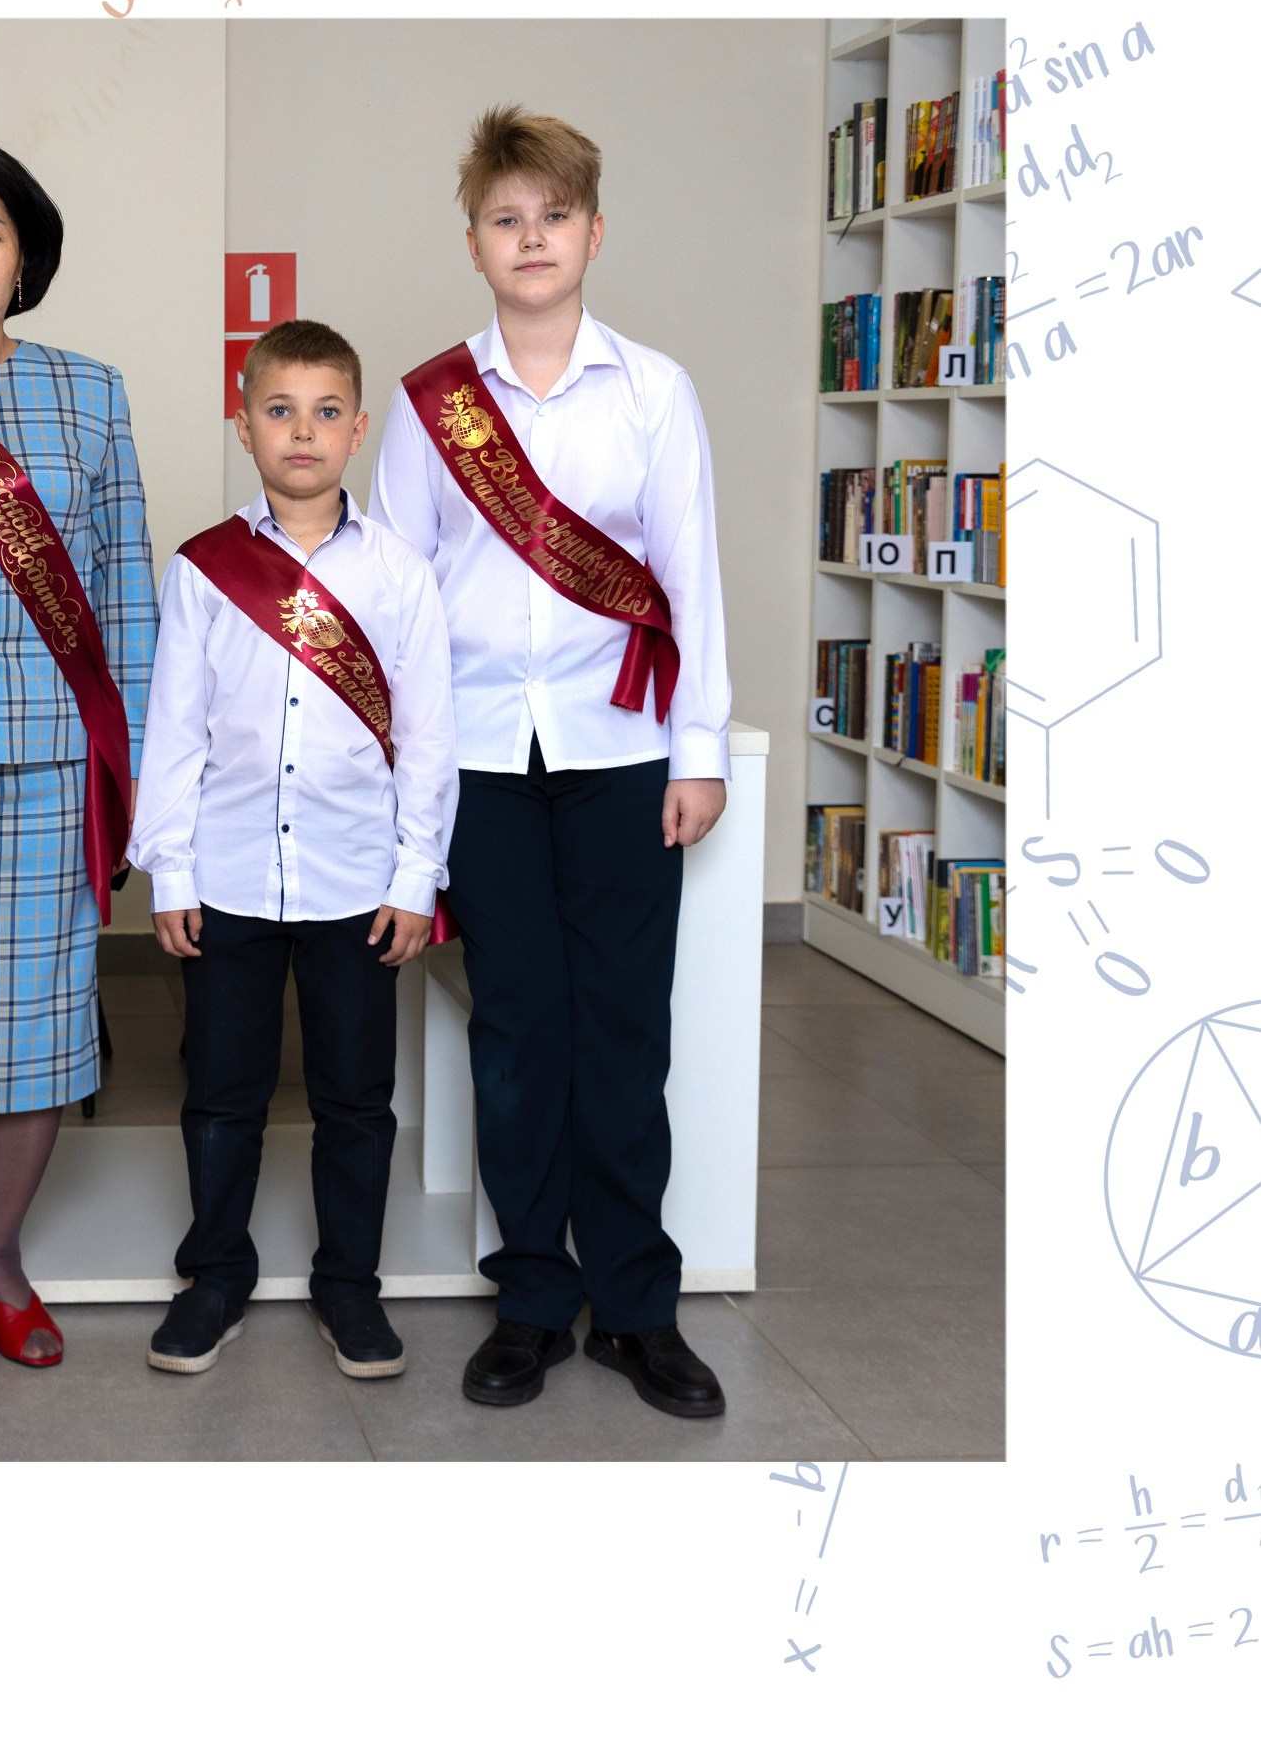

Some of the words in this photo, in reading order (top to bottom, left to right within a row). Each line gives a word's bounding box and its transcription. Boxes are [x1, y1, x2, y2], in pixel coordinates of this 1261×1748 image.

[944, 353, 966, 378] Л
[454, 450, 532, 546] начальной
[529, 545, 597, 598] школы
[479, 446, 606, 571] Выпускник
[936, 550, 956, 575] П
